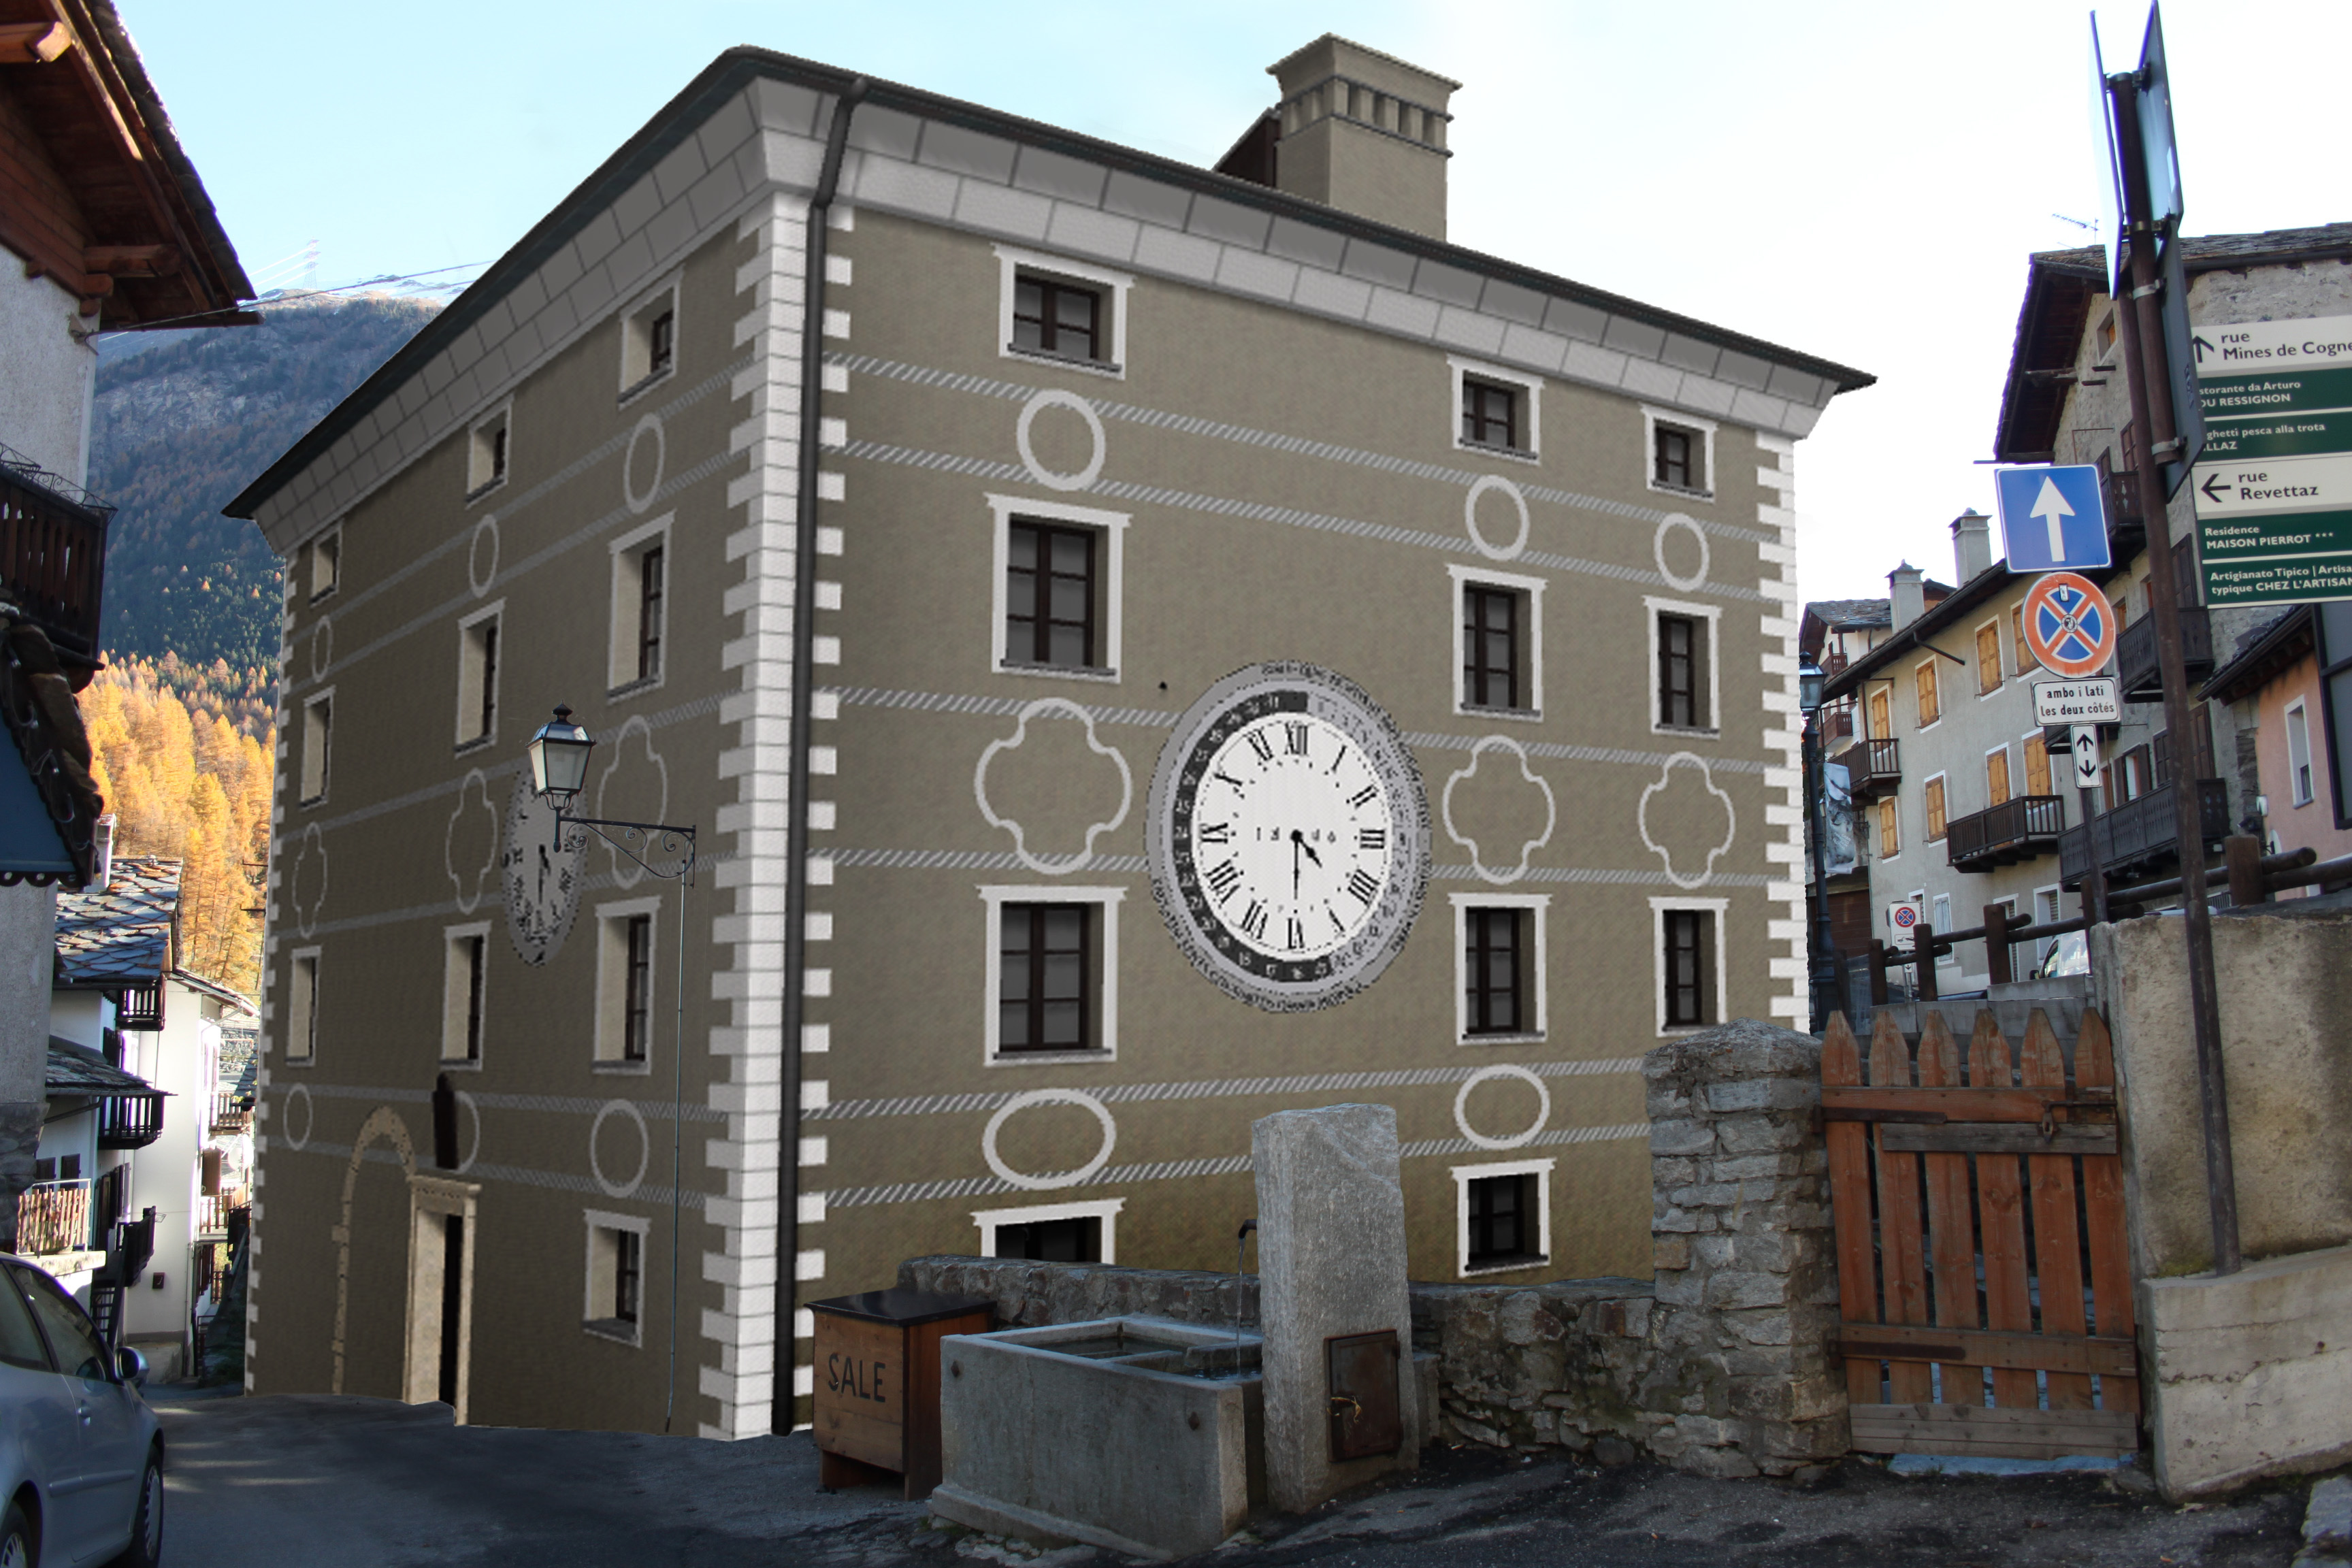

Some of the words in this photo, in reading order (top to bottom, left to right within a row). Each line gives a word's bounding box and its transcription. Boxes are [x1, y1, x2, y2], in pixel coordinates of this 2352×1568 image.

[2221, 333, 2250, 344] rue
[2223, 347, 2272, 360] Mines
[2277, 344, 2297, 356] de
[2199, 385, 2245, 395] storante
[2248, 382, 2261, 391] da
[2263, 381, 2301, 391] Arturo
[2219, 393, 2291, 406] RESSIGNON
[2206, 427, 2239, 441] ghetti
[2242, 428, 2272, 438] pesca
[2275, 424, 2294, 434] alla
[2298, 423, 2325, 432] trota
[2203, 441, 2238, 451] LLAZ
[2238, 472, 2268, 483] rue
[2240, 486, 2319, 500] Revettaz
[2204, 526, 2260, 536] Residence
[2206, 538, 2257, 549] MAISON
[2259, 534, 2311, 546] PIERROT
[2210, 570, 2273, 582] Artigianato
[2274, 567, 2309, 577] Tipico
[2211, 585, 2253, 596] typique
[2255, 581, 2290, 591] CHEZ
[2046, 687, 2074, 698] ambo
[2078, 686, 2082, 697] i
[2085, 685, 2104, 696] lati
[2040, 705, 2056, 717] les
[2060, 704, 2085, 715] deux
[2087, 702, 2114, 714] côtés
[1359, 828, 1385, 849] III
[828, 1351, 886, 1403] SALE
